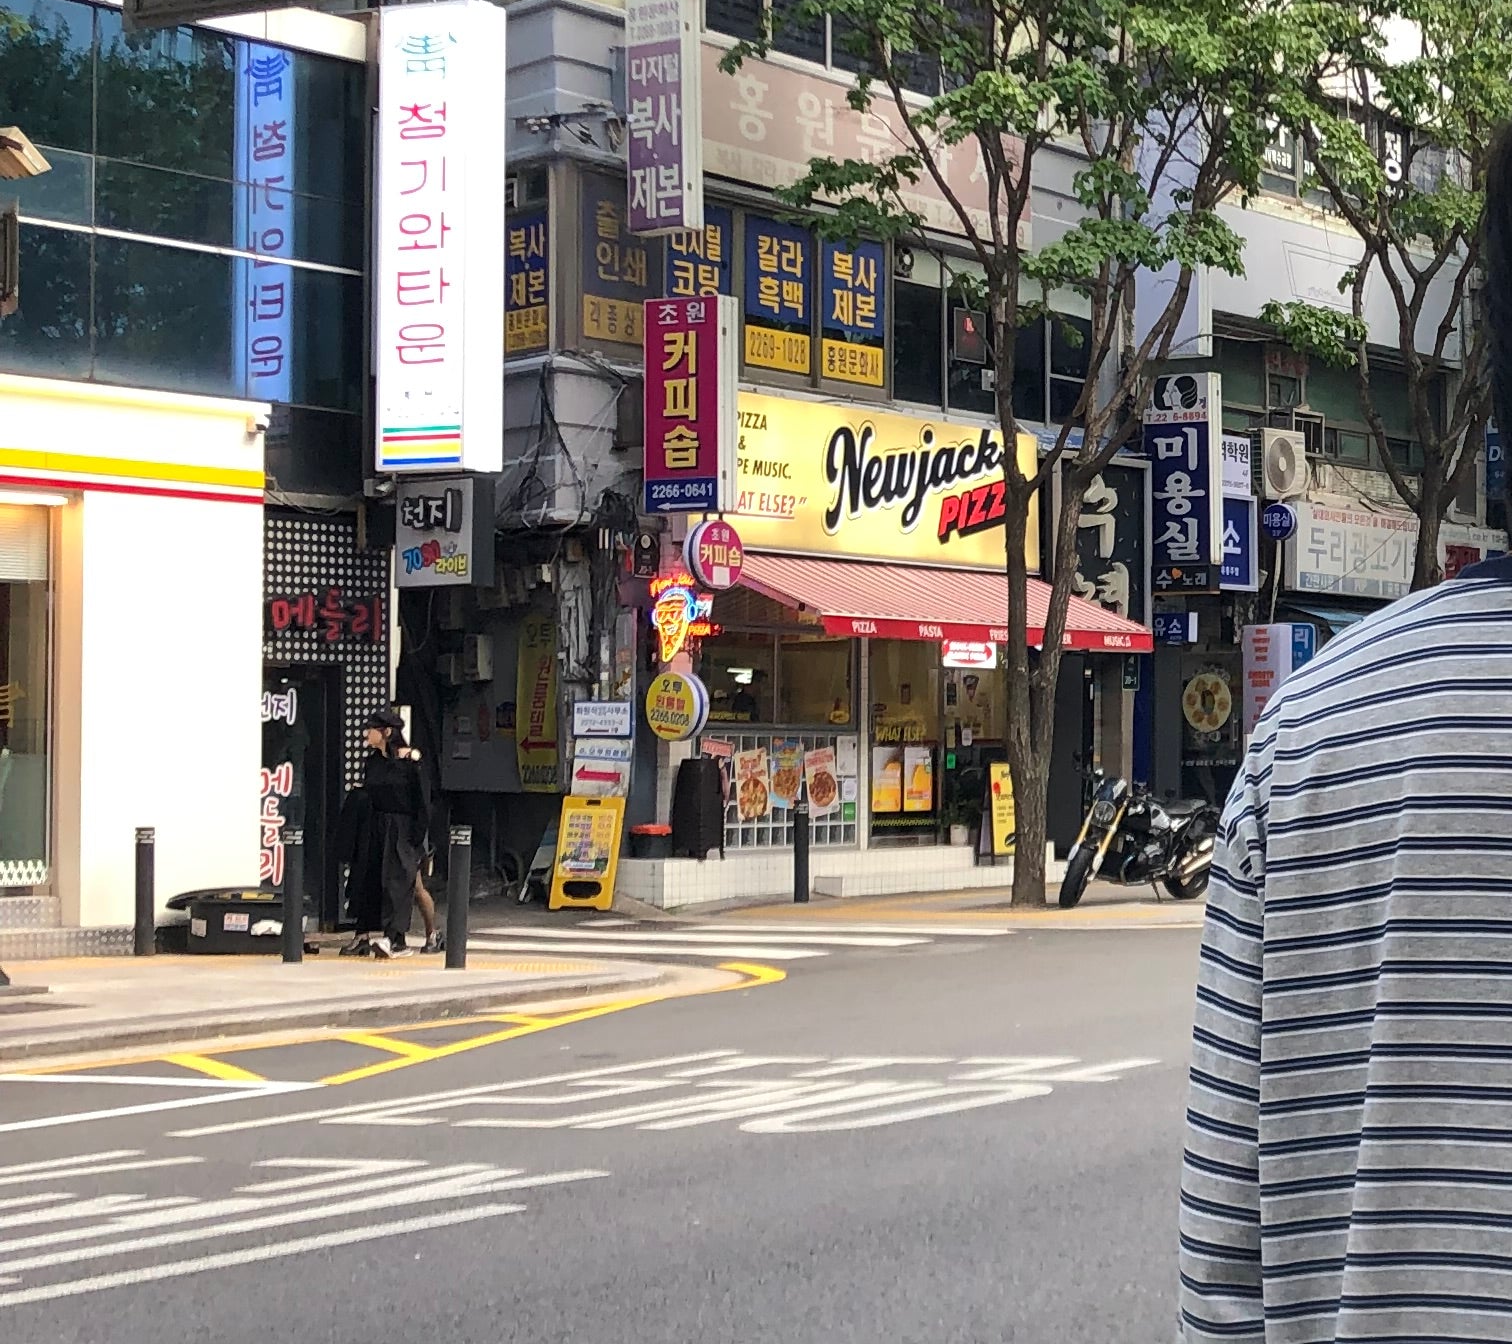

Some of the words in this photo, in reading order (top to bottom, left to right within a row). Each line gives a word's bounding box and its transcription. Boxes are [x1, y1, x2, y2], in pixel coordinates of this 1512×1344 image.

[630, 53, 679, 87] 디지털
[629, 93, 681, 150] 복사
[631, 163, 683, 220] 제본
[396, 101, 452, 365] 청기와타운
[509, 222, 545, 263] 복사
[596, 241, 647, 287] 인쇄
[758, 234, 804, 278] 칼라
[833, 250, 877, 294] 복사
[510, 269, 545, 307] 제본
[672, 259, 720, 297] 코팅
[758, 276, 804, 318] 흑백
[832, 288, 876, 329] 제본
[750, 330, 807, 366] 2269-1028
[827, 345, 880, 382] 홍원문화사
[662, 330, 699, 469] 커피숍
[752, 458, 792, 480] MUSIC.
[651, 482, 713, 499] 2266-0641
[1152, 426, 1206, 561] 미용실
[403, 498, 452, 528] 천지
[937, 479, 1006, 543] PIZZ
[1263, 512, 1291, 528] 미용실
[435, 554, 467, 575] 라이브
[700, 544, 741, 567] 커피숍
[1308, 526, 1417, 581] 두리광고기
[271, 589, 382, 642] 메들리
[851, 620, 878, 634] PIZZA
[919, 624, 944, 639] PASTA
[660, 678, 683, 695] 오투
